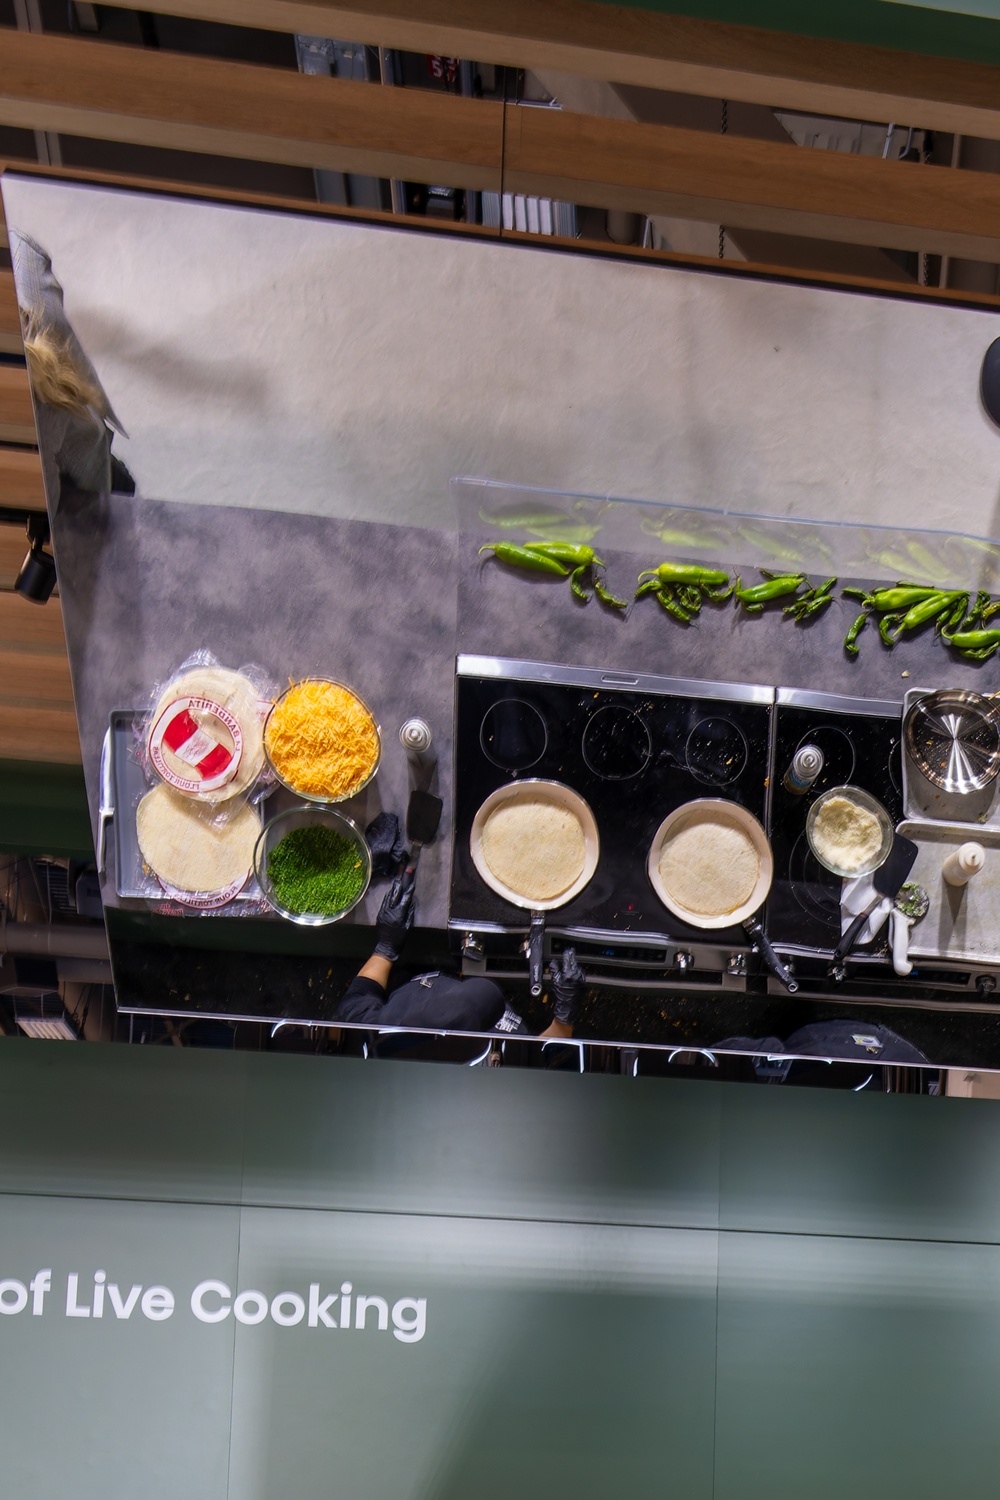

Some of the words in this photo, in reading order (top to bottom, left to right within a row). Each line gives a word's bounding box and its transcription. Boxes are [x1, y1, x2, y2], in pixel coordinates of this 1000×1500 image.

[0, 1268, 52, 1316] of
[66, 1269, 175, 1321] Live
[190, 1279, 427, 1343] Cooking
